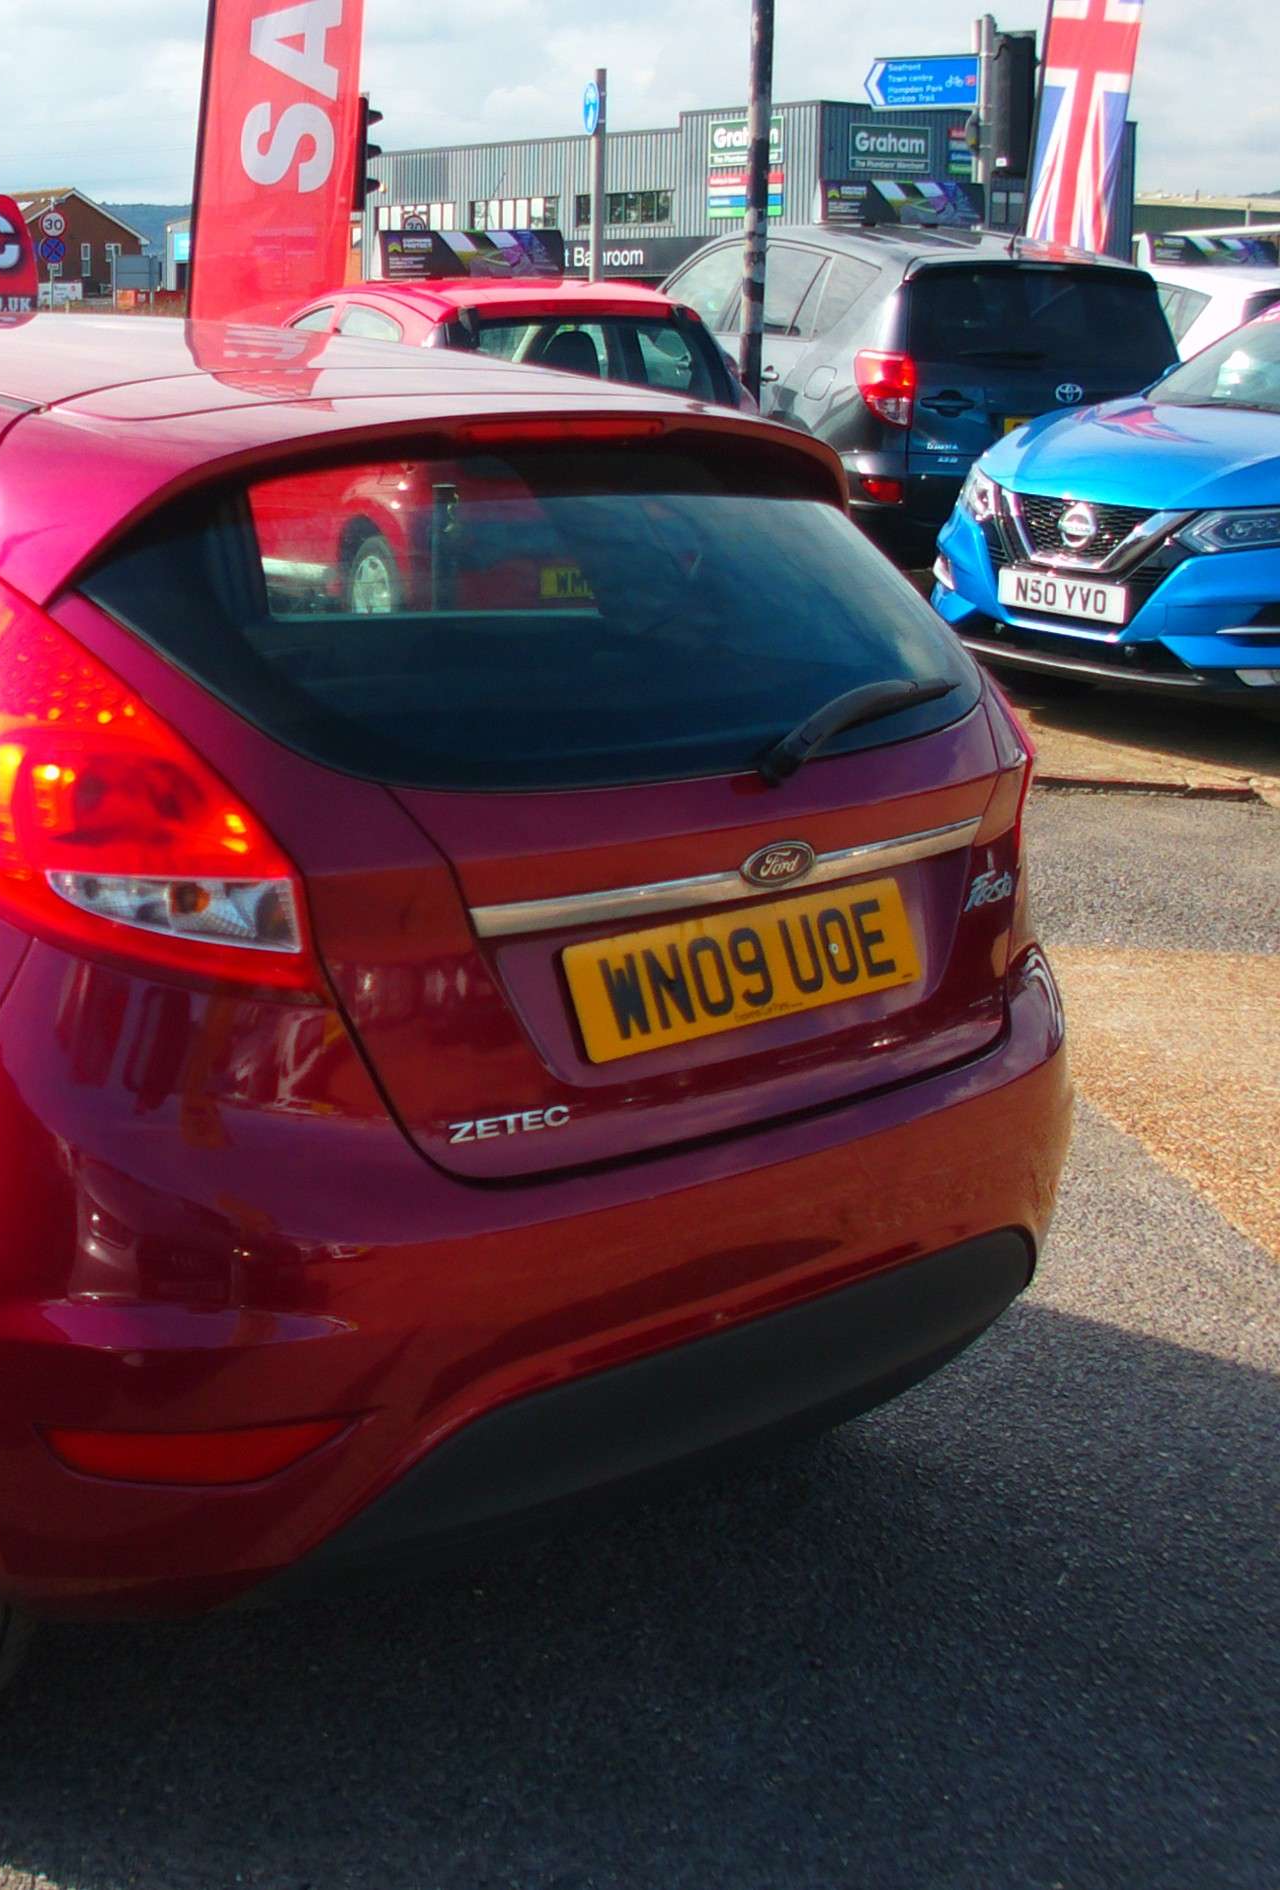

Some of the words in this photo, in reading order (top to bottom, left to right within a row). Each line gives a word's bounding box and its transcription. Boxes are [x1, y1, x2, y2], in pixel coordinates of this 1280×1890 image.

[887, 63, 922, 72] Seafront
[887, 75, 908, 83] Town
[887, 86, 924, 95] Hampden
[887, 95, 917, 103] Cuckoo
[918, 94, 936, 102] Trail
[855, 131, 926, 154] Graham
[44, 218, 63, 231] 30
[1015, 576, 1057, 606] N50
[1064, 583, 1107, 615] YVO
[760, 850, 801, 877] Ford
[597, 926, 775, 1041] WN09
[778, 897, 897, 994] UOE
[448, 1104, 570, 1144] ZETEC
